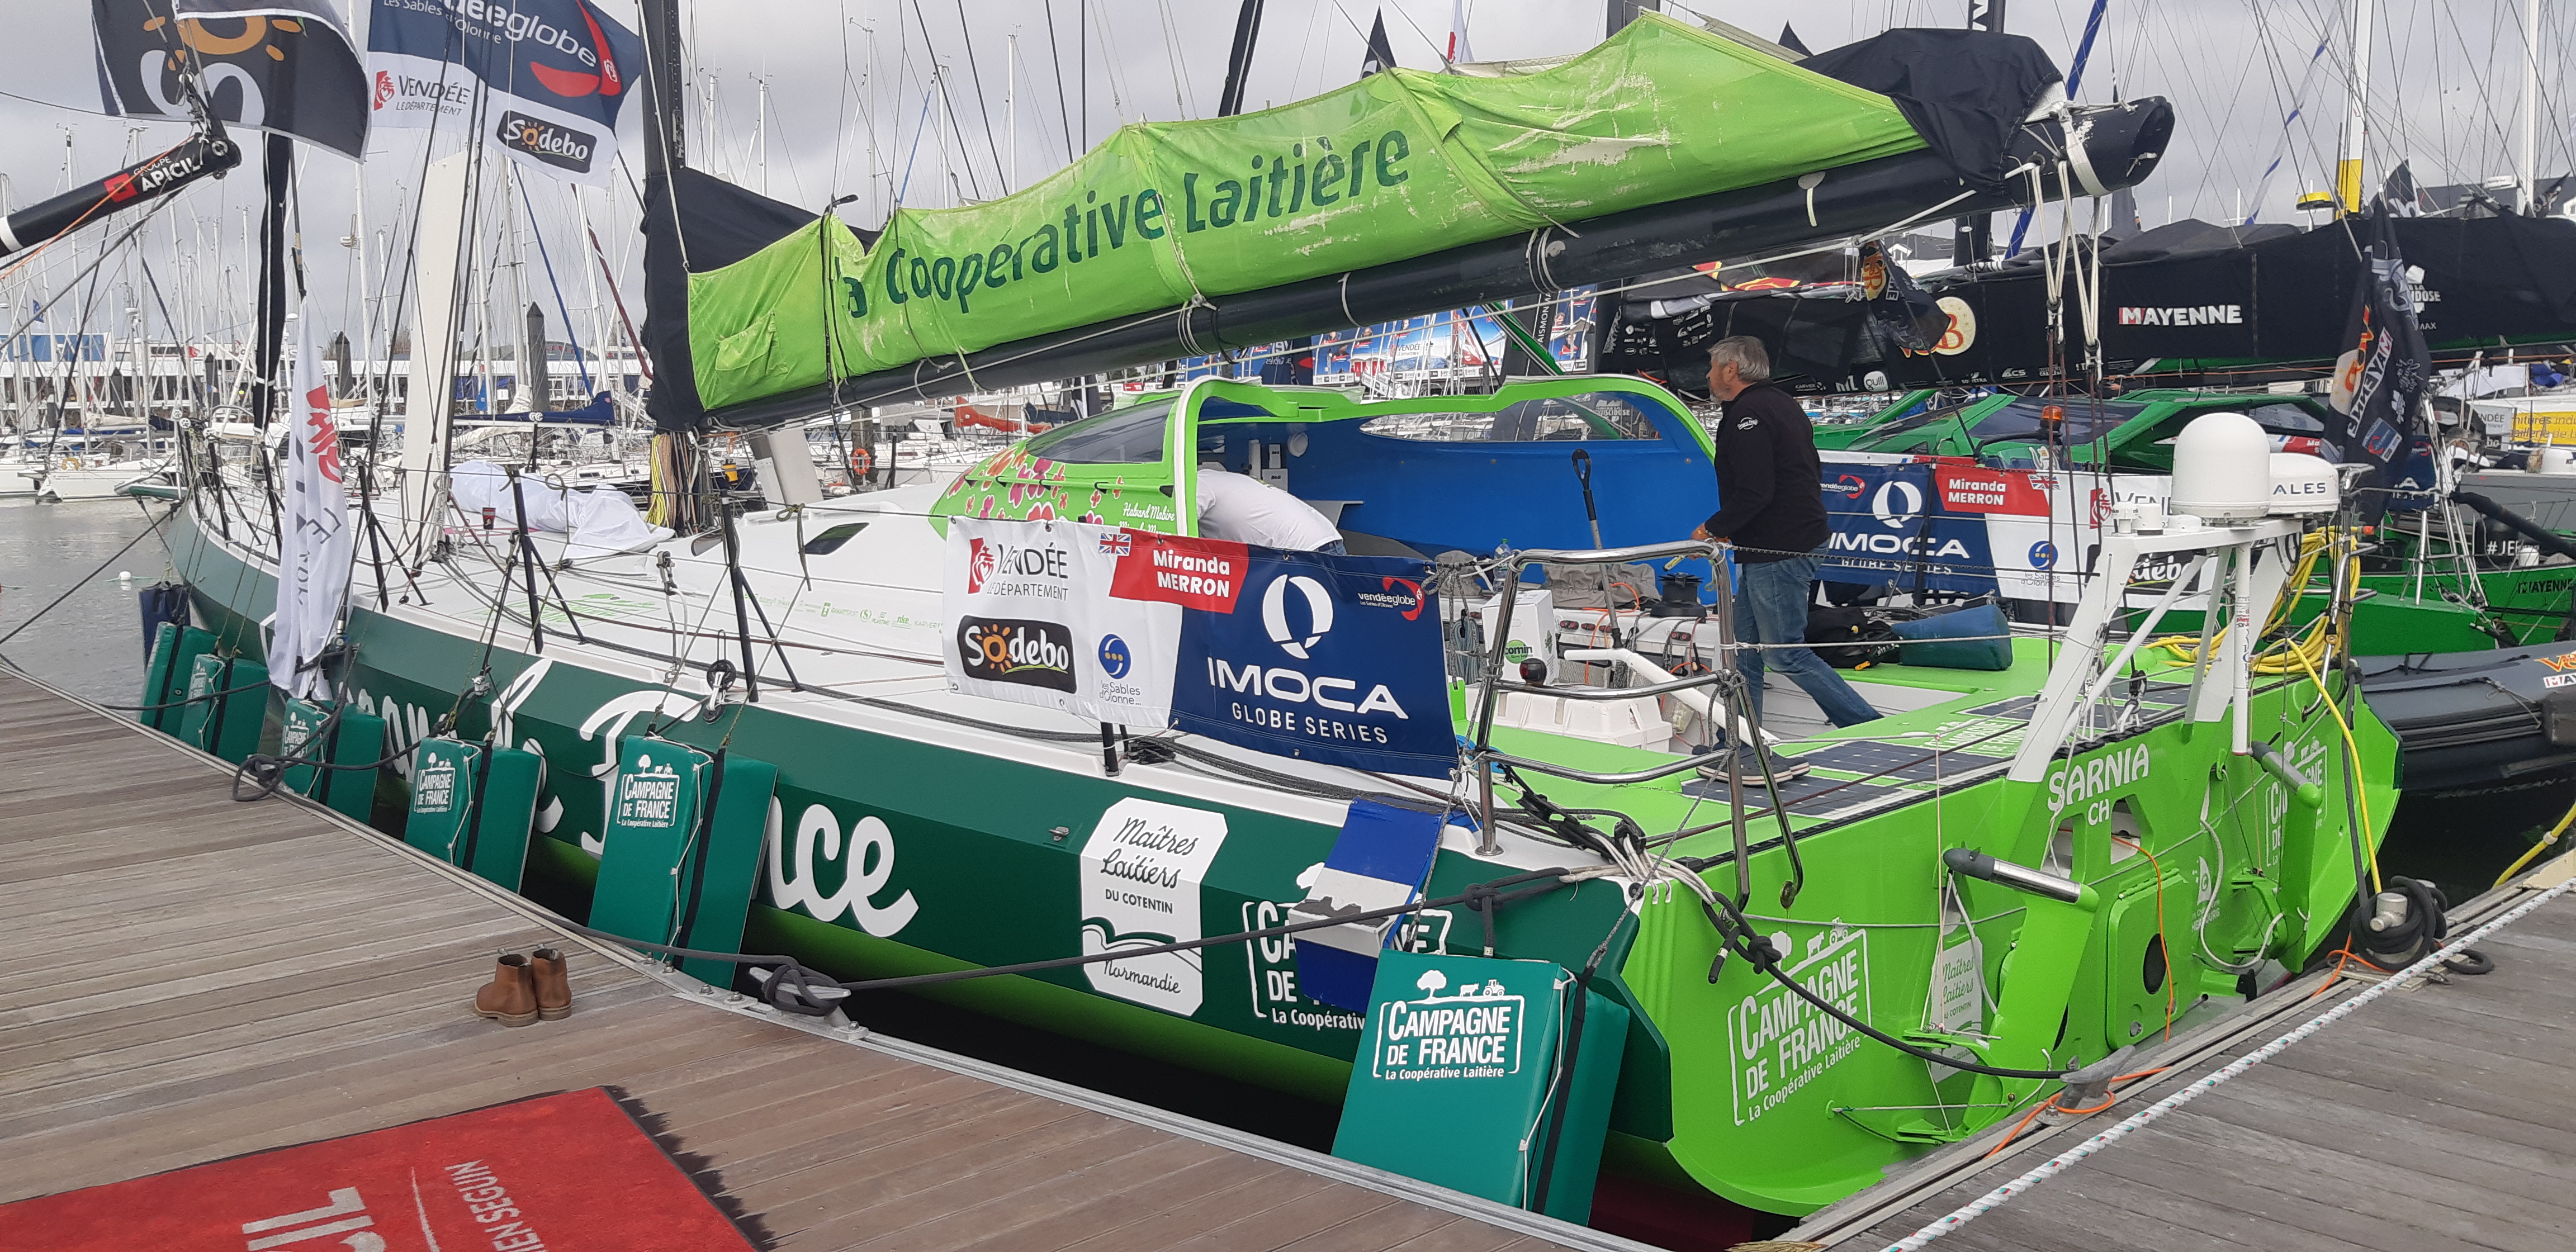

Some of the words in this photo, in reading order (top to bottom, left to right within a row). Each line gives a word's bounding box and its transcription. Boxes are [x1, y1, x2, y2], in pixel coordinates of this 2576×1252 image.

[399, 75, 471, 105] VENDÉE
[504, 119, 589, 160] Sodebo
[141, 158, 202, 193] APICIL
[885, 188, 1164, 314] Coopérative
[1184, 129, 1412, 234] Laitière
[2119, 305, 2243, 326] MAYENNE
[1865, 376, 1884, 391] gulli
[1948, 478, 2007, 492] Miranda
[1948, 492, 2004, 506] MERRON
[997, 542, 1069, 580] VENDÉE
[1153, 549, 1230, 576] Miranda
[994, 580, 1069, 601] DÉPARTEMENT
[1157, 571, 1230, 598] MERRON
[1357, 592, 1415, 606] vendéeglobe
[964, 625, 1070, 671] Sodebo
[1110, 681, 1141, 696] Sables
[1207, 657, 1409, 719] IMOCA
[1232, 701, 1296, 732] GLOBE
[1305, 716, 1388, 744] SERIES
[419, 769, 452, 792] CAMPAGNE
[624, 773, 675, 800] CAMPAGNE
[2047, 742, 2150, 813] SARNIA
[425, 789, 449, 805] FRANCE
[622, 803, 633, 817] DE
[634, 800, 671, 819] FRANCE
[2087, 799, 2110, 826] CH
[1112, 816, 1199, 856] Maîtres
[1100, 848, 1181, 890] Laitiers
[1105, 889, 1119, 902] DU
[1122, 893, 1173, 915] COTENTIN
[1104, 959, 1181, 995] Normandie
[1267, 970, 1298, 1003] DE
[1272, 1008, 1287, 1025] La
[1290, 1009, 1365, 1031] Coopérativ
[1740, 948, 1859, 1061] CAMPAGNE
[1388, 1000, 1512, 1041] CAMPAGNE
[1386, 1044, 1409, 1065] DE
[1418, 1035, 1507, 1065] FRANCE
[1745, 1057, 1769, 1100] DE
[1778, 991, 1859, 1079] FRANCE
[1385, 1069, 1397, 1080] La
[1399, 1066, 1460, 1082] Coopérative
[1463, 1066, 1505, 1079] Laitière
[1749, 1106, 1761, 1122] La
[1763, 1065, 1823, 1111] Coopérative
[1825, 1036, 1861, 1070] Laitière
[443, 1159, 523, 1223] SEGUIN
